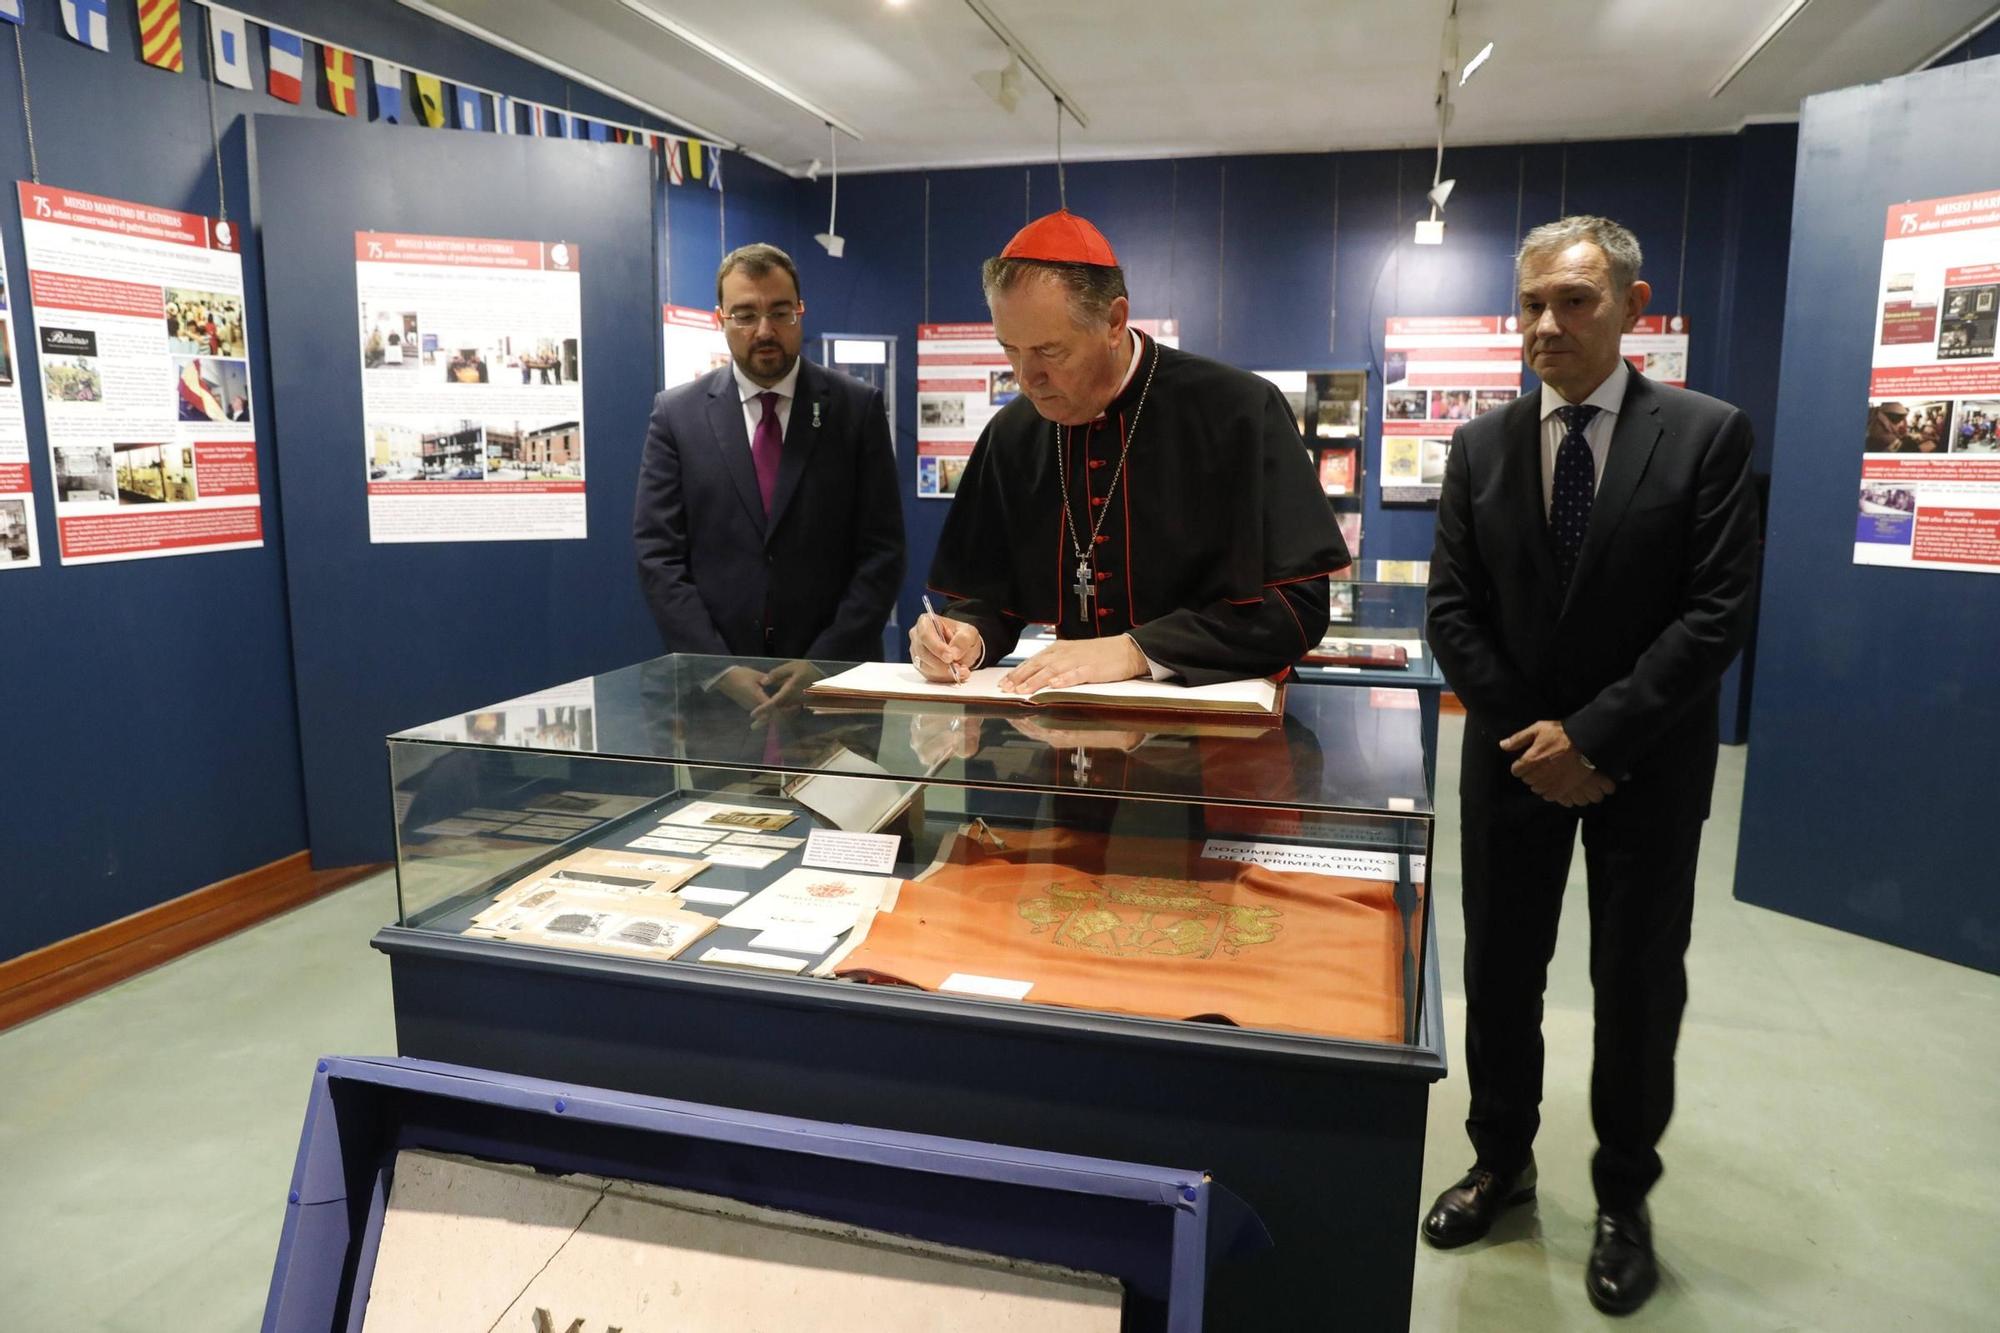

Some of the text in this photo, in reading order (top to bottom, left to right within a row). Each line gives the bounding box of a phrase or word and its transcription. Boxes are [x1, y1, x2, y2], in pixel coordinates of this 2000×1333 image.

[33, 195, 52, 217] 75
[64, 196, 94, 211] MUSEO
[1935, 202, 1970, 216] MUSEO
[1900, 213, 1919, 235] 75
[368, 241, 384, 259] 75
[1208, 846, 1313, 860] DOCUMENTOS
[1331, 855, 1395, 866] OBJETOS
[1263, 858, 1332, 869] PRIMERA
[1336, 863, 1382, 873] ETAPA
